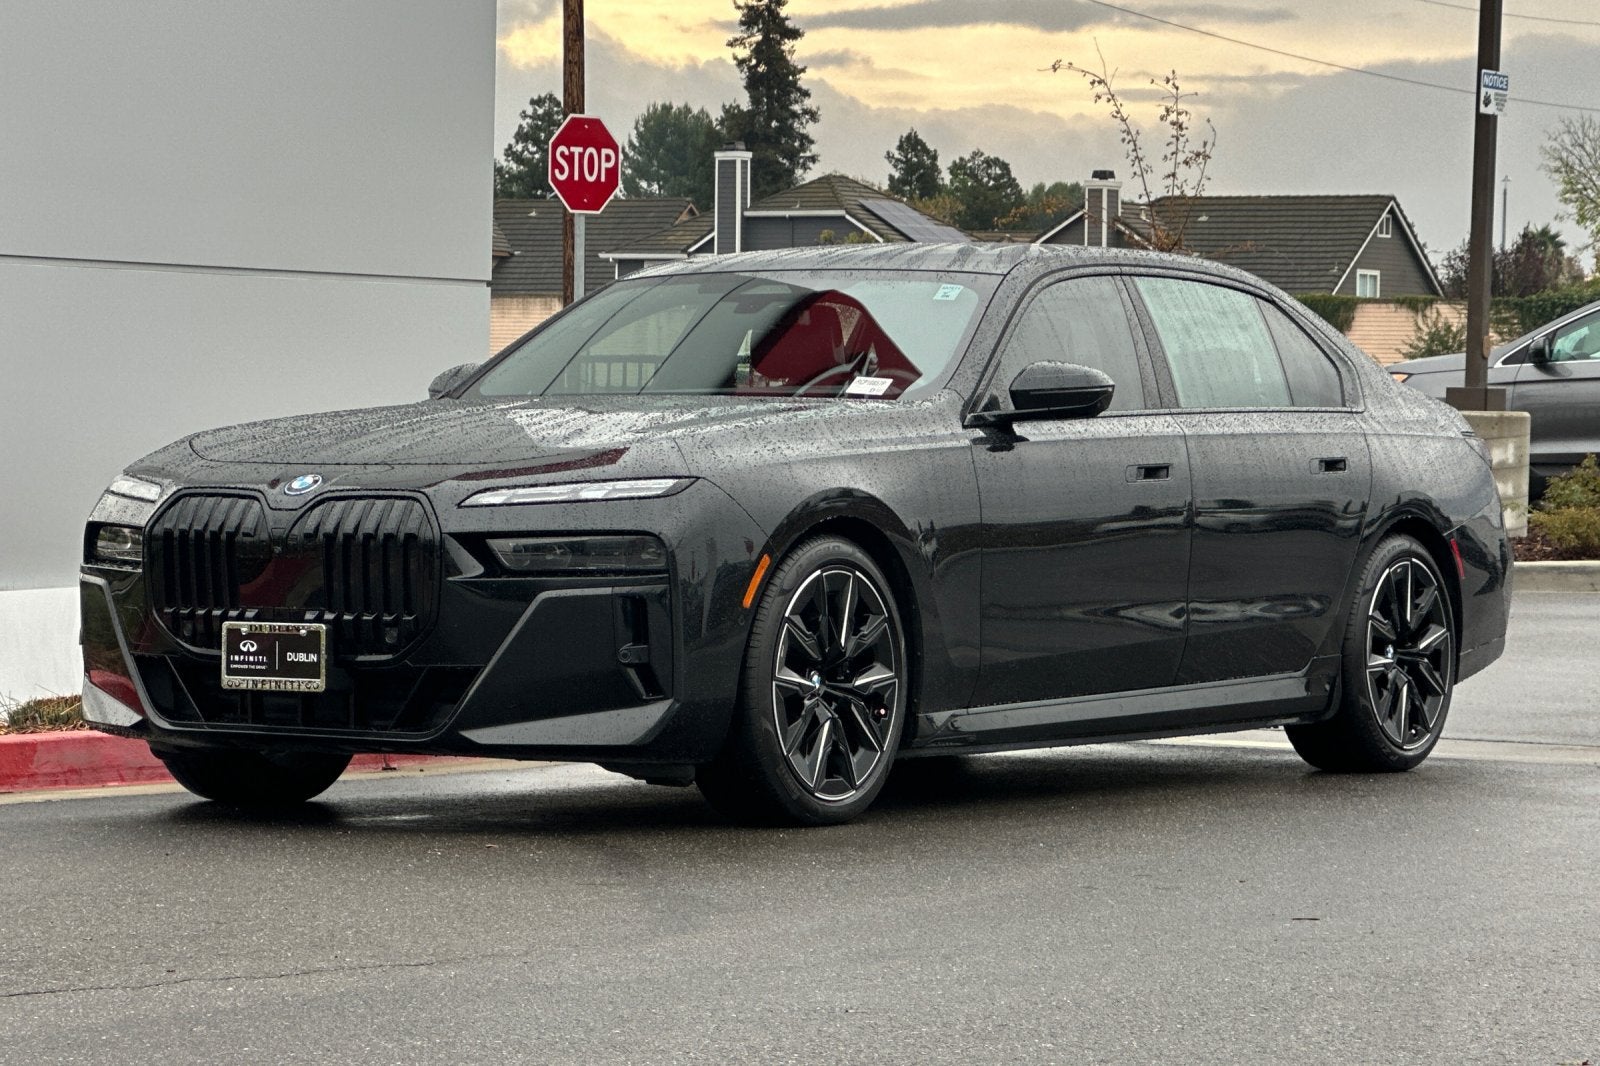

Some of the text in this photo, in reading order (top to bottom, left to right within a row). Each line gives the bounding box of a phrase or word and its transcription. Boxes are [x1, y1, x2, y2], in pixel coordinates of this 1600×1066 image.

[1483, 75, 1508, 89] NOTICE
[554, 145, 616, 183] STOP
[286, 652, 317, 662] DUBLIN
